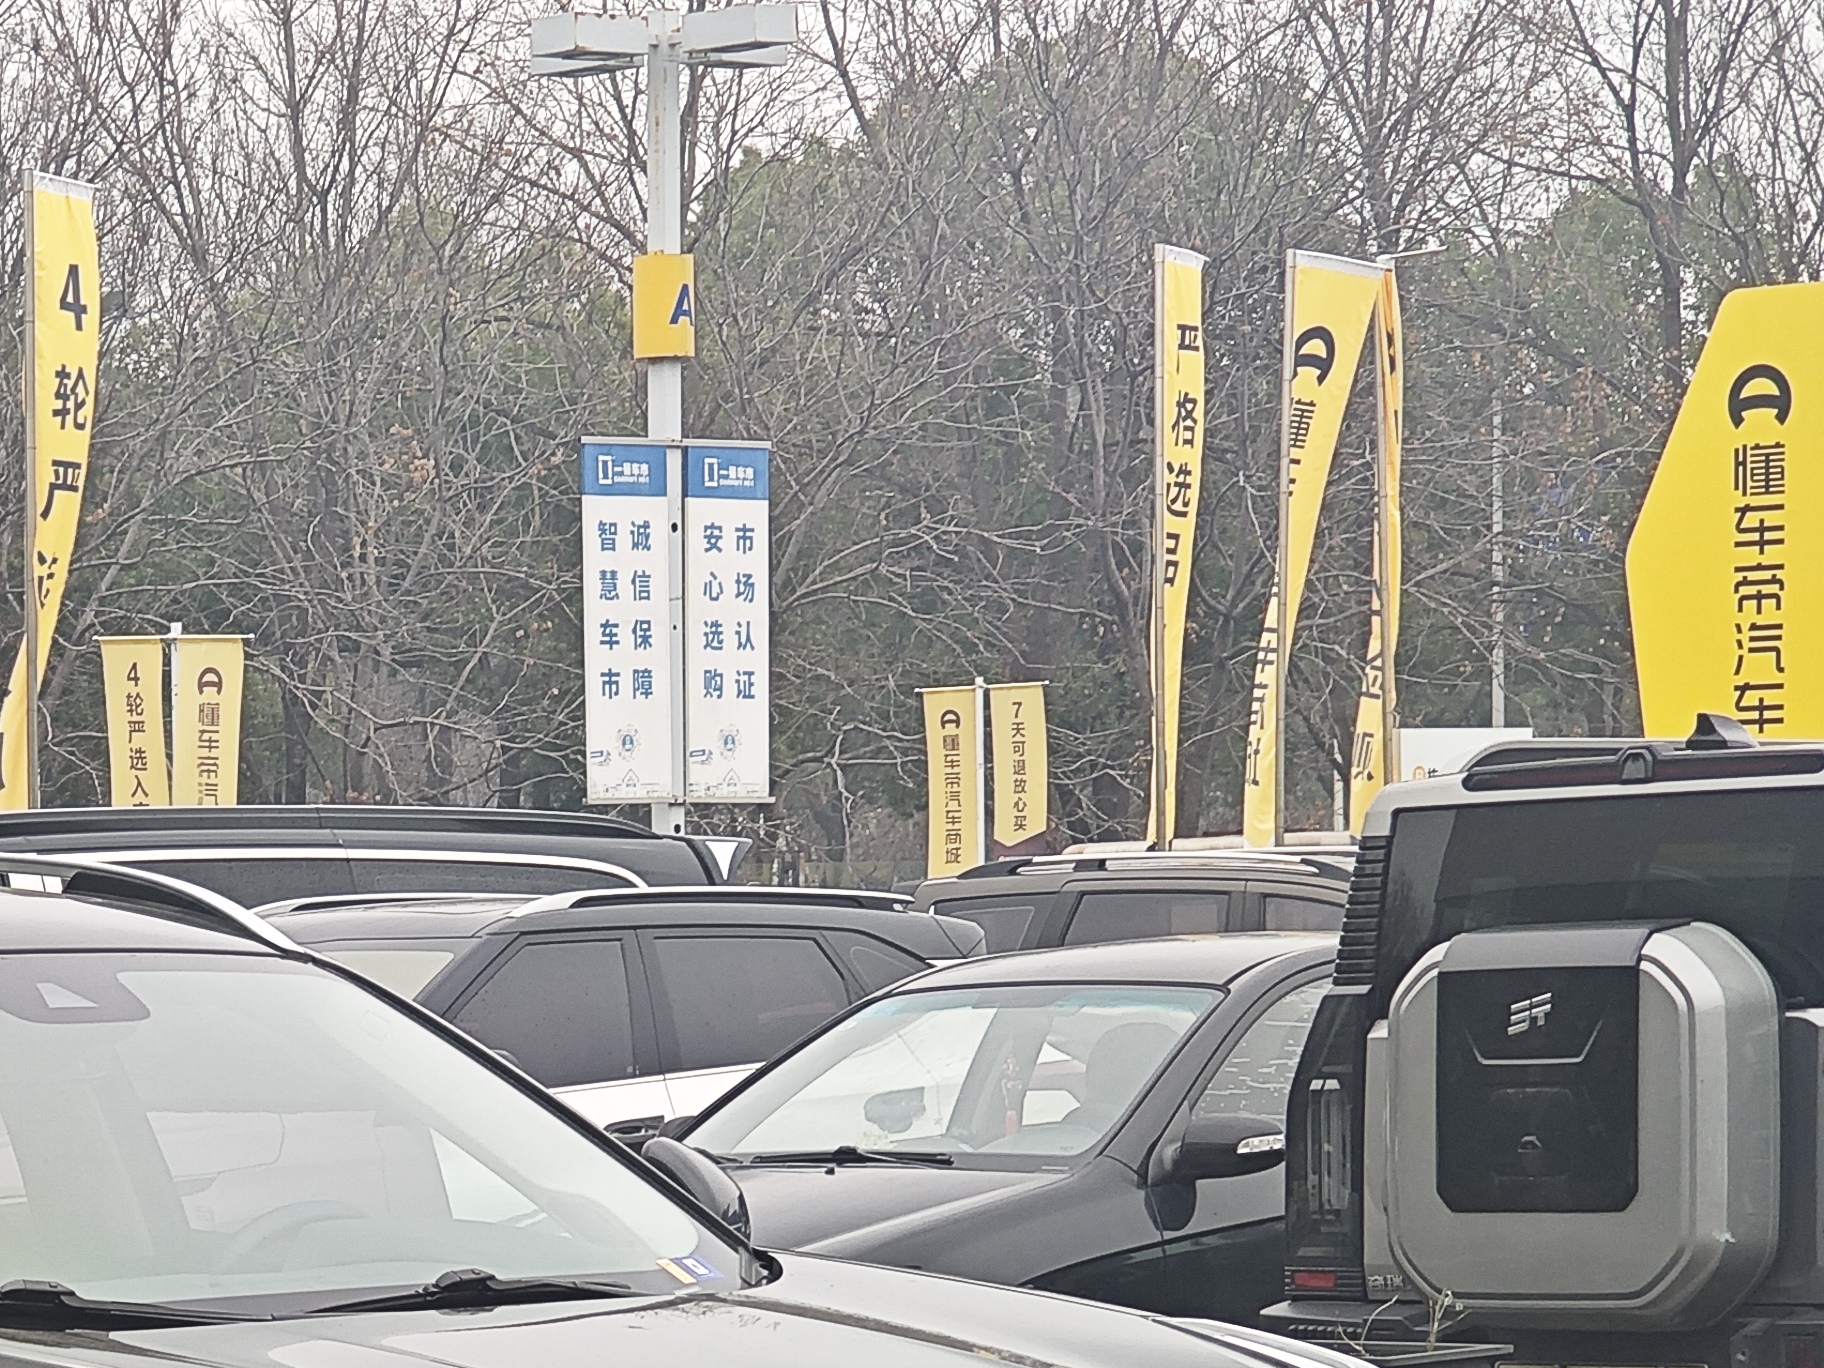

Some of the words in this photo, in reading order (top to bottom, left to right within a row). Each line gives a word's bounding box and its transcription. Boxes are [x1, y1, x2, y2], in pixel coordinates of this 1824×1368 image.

[597, 519, 621, 700] 智慧车市
[629, 520, 653, 700] 诚信保障
[703, 522, 724, 700] 安心选购
[734, 523, 756, 700] 市场认证
[1733, 441, 1786, 735] 懂车帝汽车
[126, 661, 150, 807] 4轮严选入
[942, 733, 962, 865] 懂车帝汽车商城
[1011, 701, 1028, 832] 7天可退放心买
